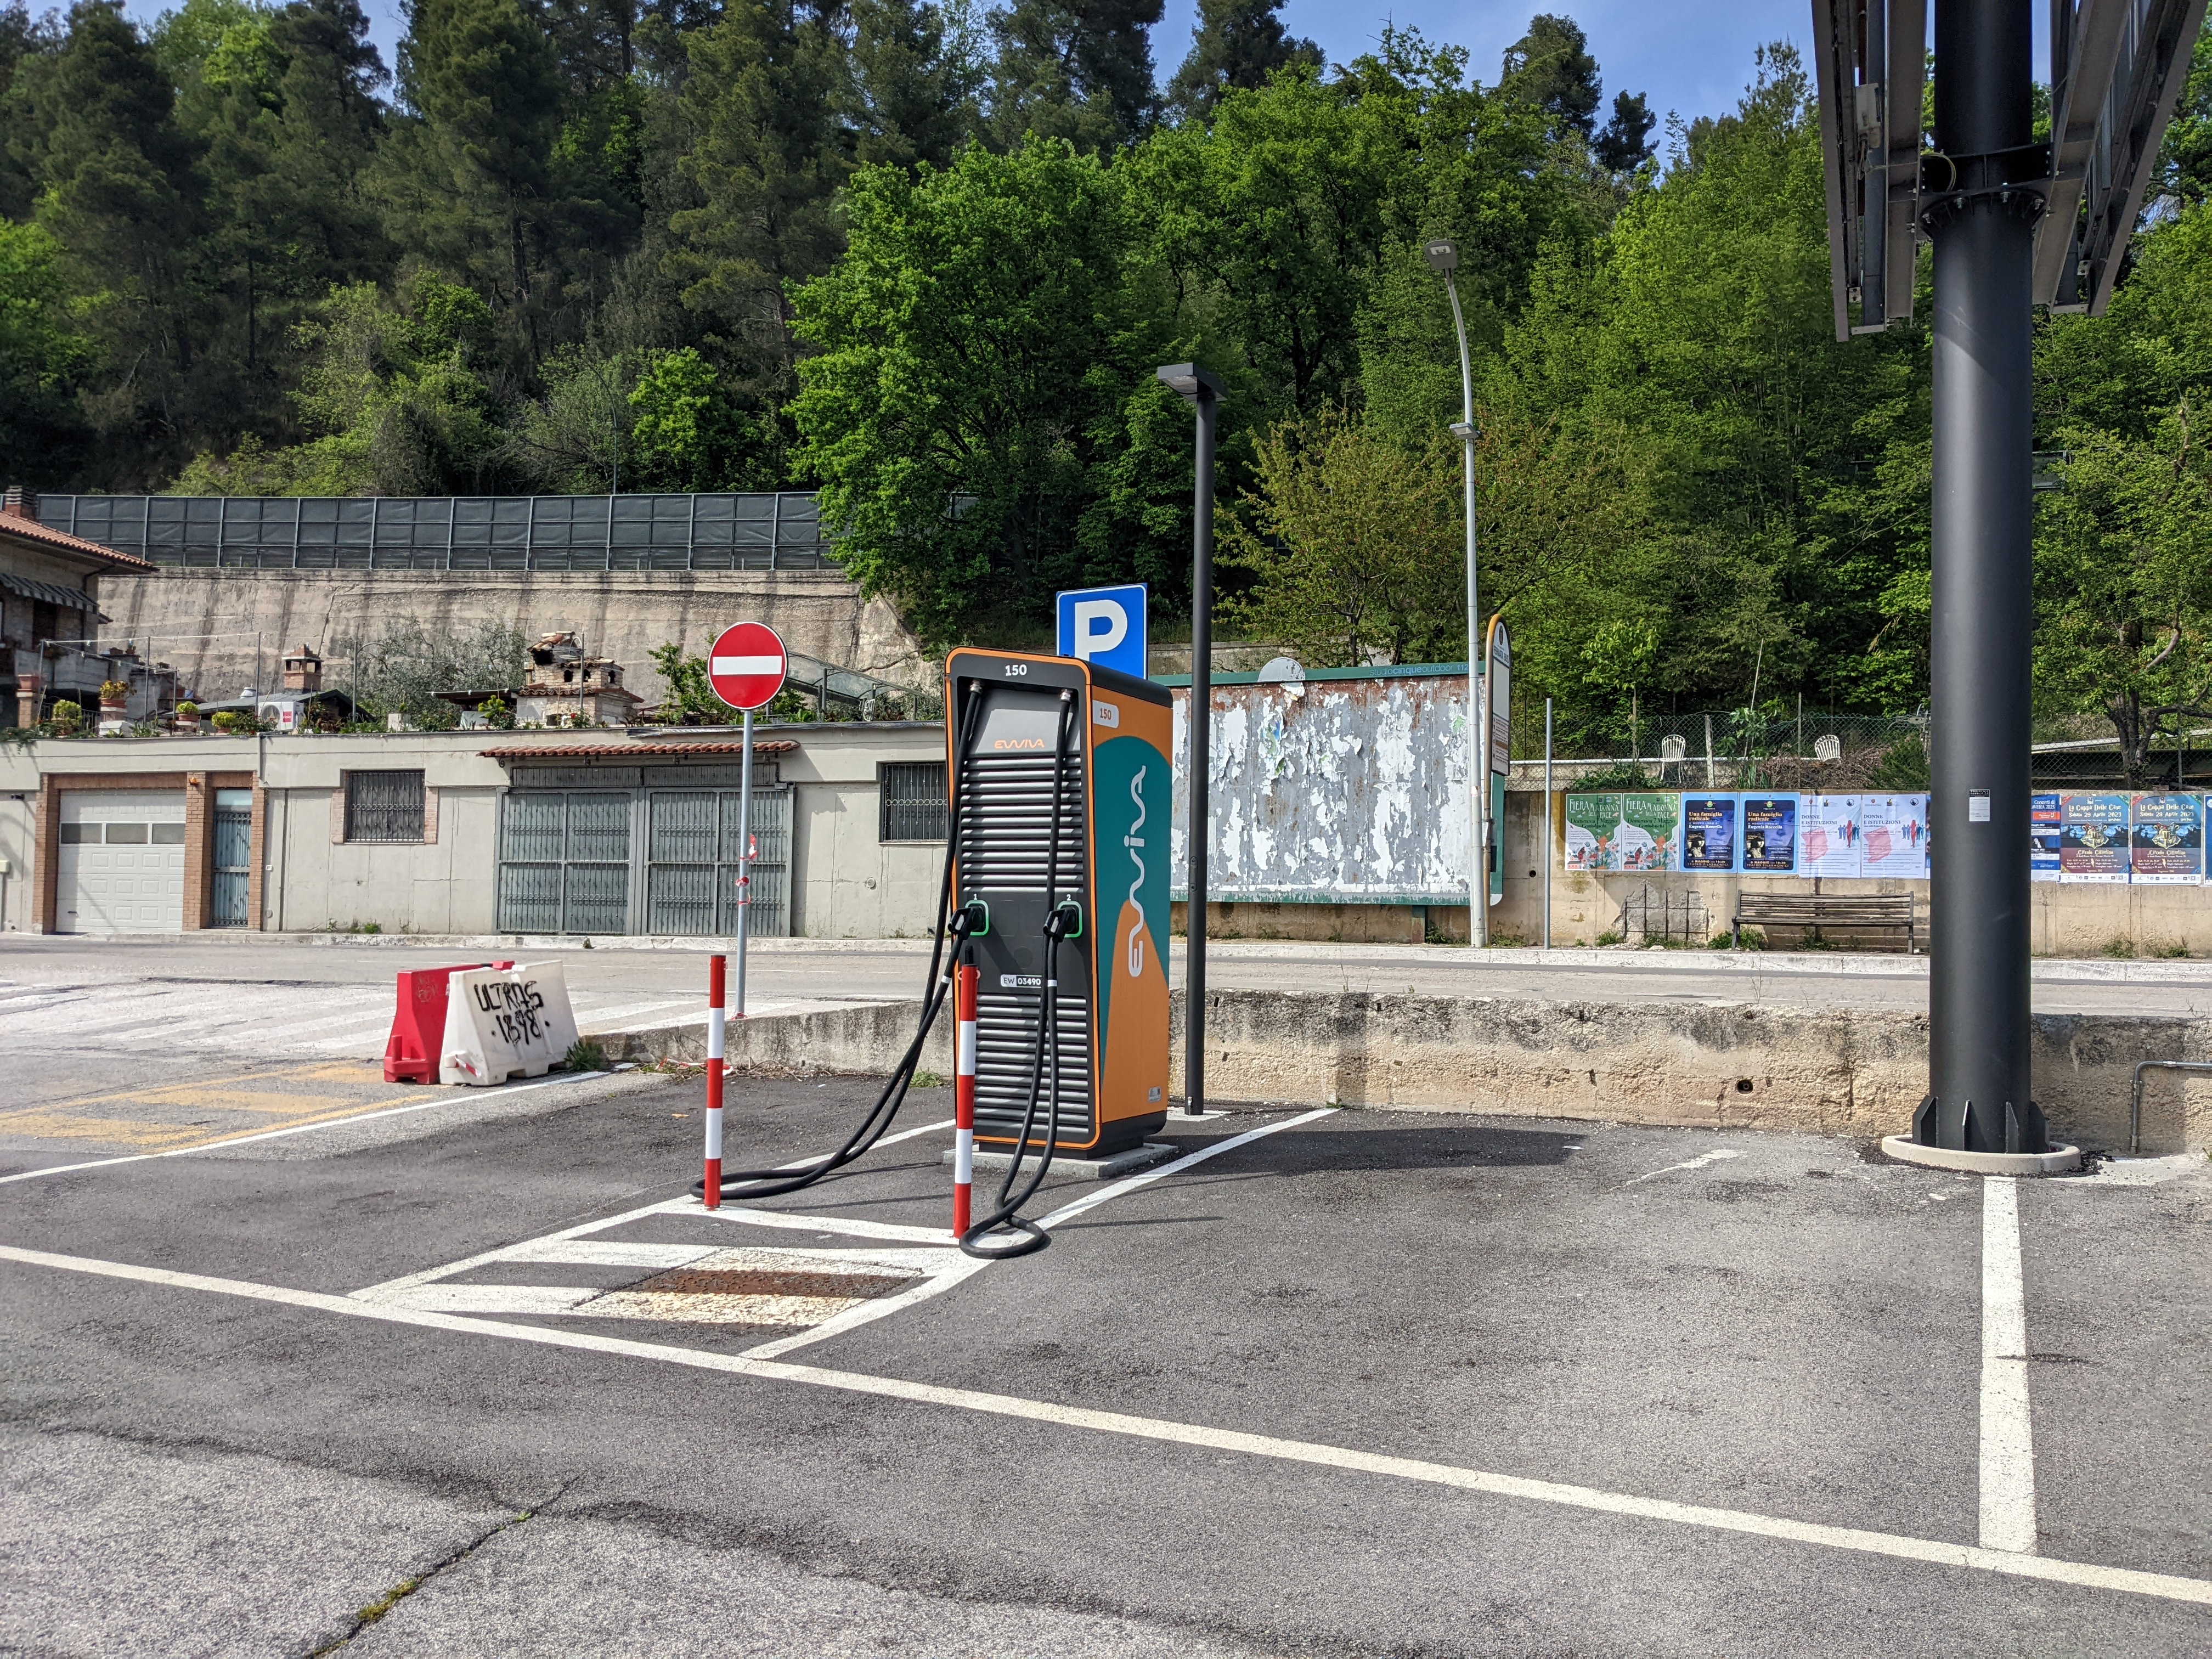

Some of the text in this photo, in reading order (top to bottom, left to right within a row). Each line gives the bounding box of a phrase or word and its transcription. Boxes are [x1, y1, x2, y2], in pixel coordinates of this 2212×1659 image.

[1075, 599, 1128, 662] P
[1005, 664, 1028, 676] 150
[1099, 707, 1112, 720] 150
[1570, 798, 1589, 811] FIERA
[1626, 798, 1677, 812] FIERA MADONNA
